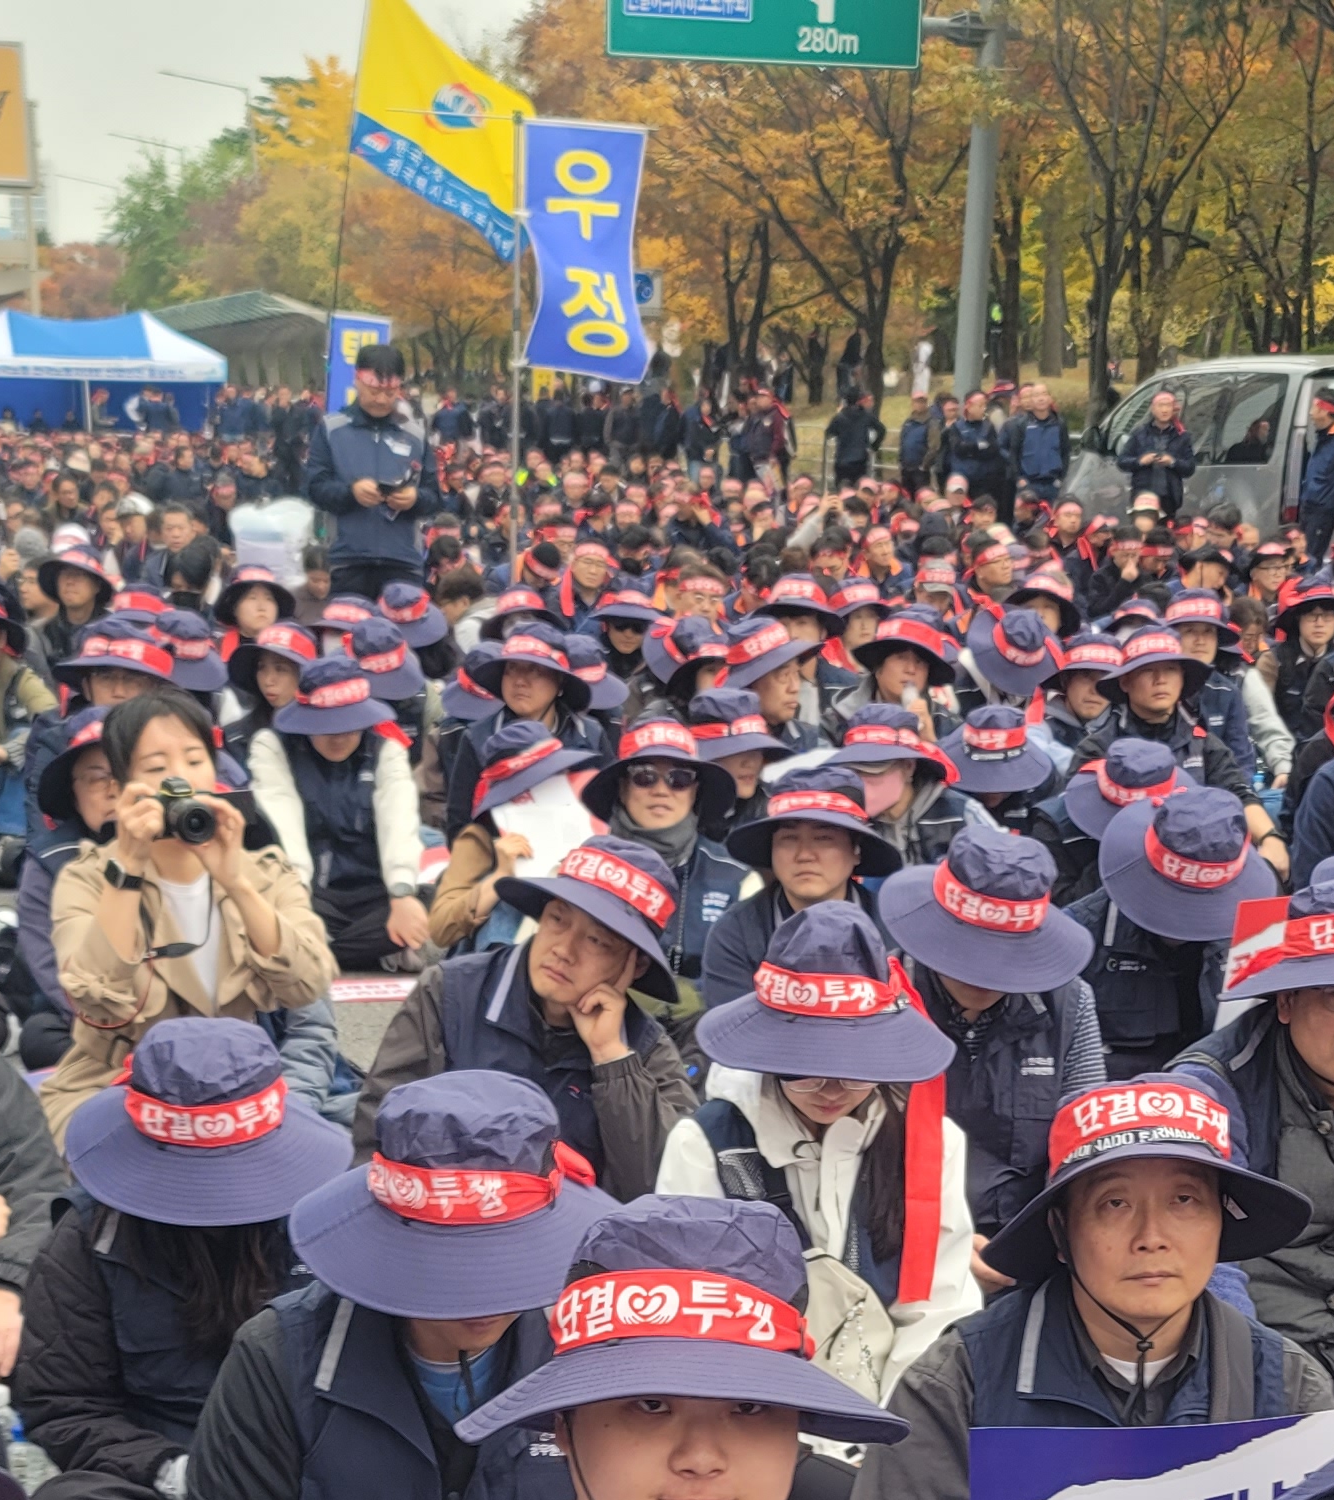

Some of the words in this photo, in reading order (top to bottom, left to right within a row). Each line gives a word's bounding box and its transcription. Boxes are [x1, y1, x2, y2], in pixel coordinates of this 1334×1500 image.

[797, 26, 859, 55] 280m
[566, 849, 600, 880] 단결
[625, 872, 666, 918] 투쟁
[820, 979, 877, 1012] 투쟁
[140, 1102, 196, 1141] 단결
[234, 1087, 283, 1135] 투쟁
[1072, 1089, 1141, 1138] 단결
[1185, 1093, 1229, 1150] 투쟁
[428, 1172, 507, 1218] 투쟁
[556, 1279, 616, 1344] 단결
[682, 1279, 777, 1341] 투쟁
